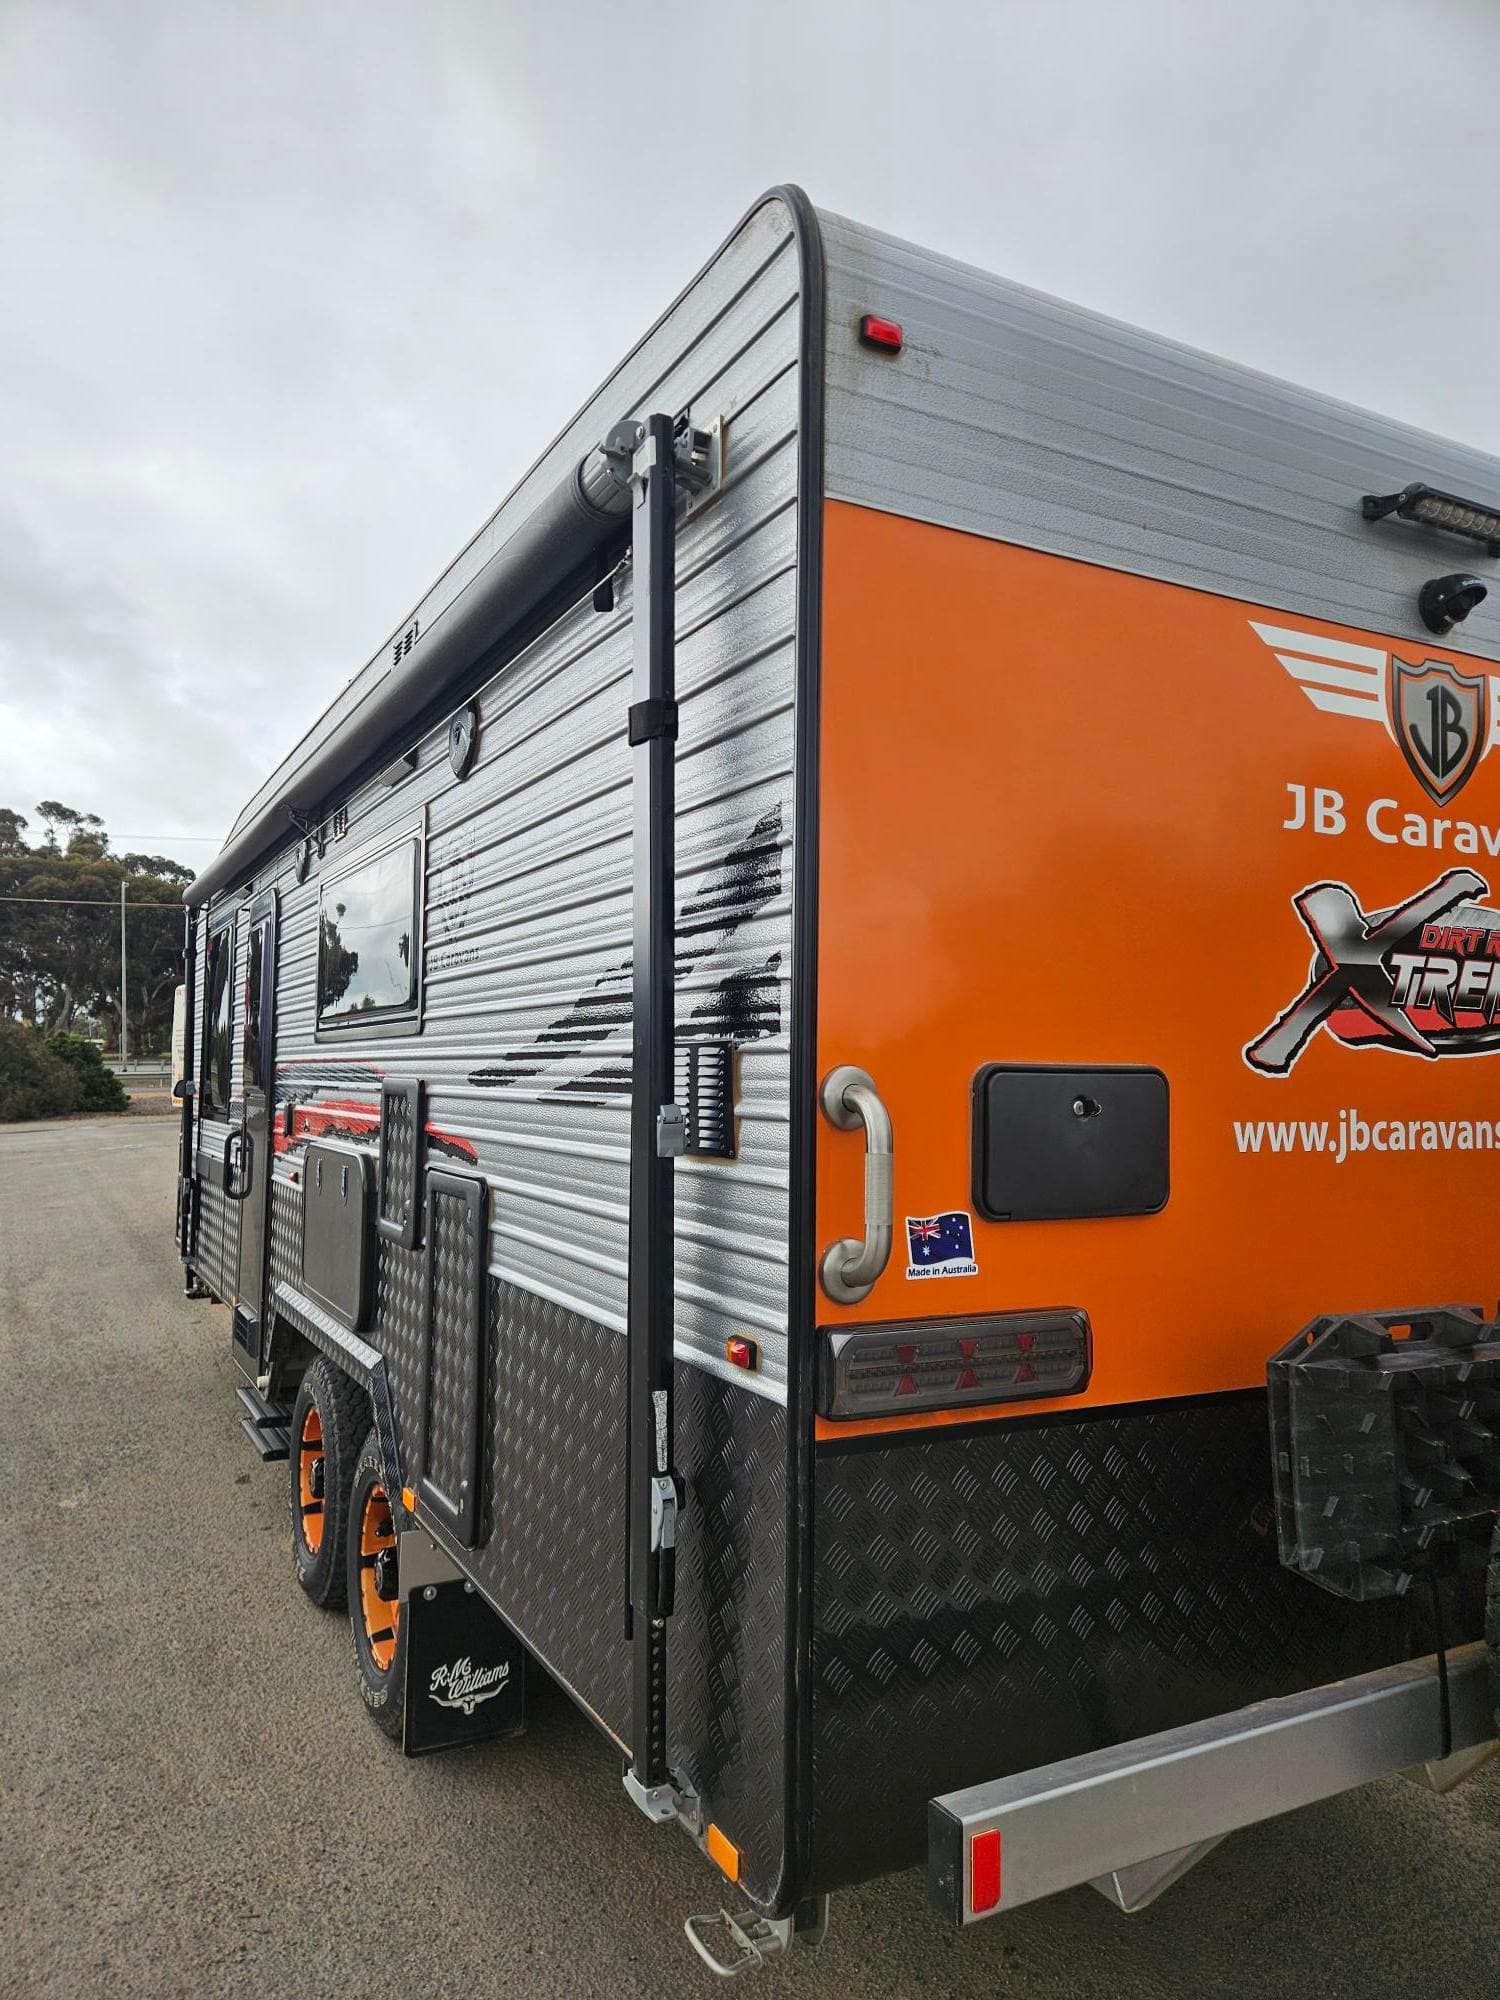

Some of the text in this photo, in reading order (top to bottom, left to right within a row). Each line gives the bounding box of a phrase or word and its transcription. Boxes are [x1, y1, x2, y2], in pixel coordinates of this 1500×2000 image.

[1408, 684, 1469, 780] JB
[1282, 782, 1500, 857] JB Carav
[1419, 923, 1486, 957] DIRT
[907, 1264, 977, 1277] Made in Australia
[447, 1660, 510, 1700] Williams
